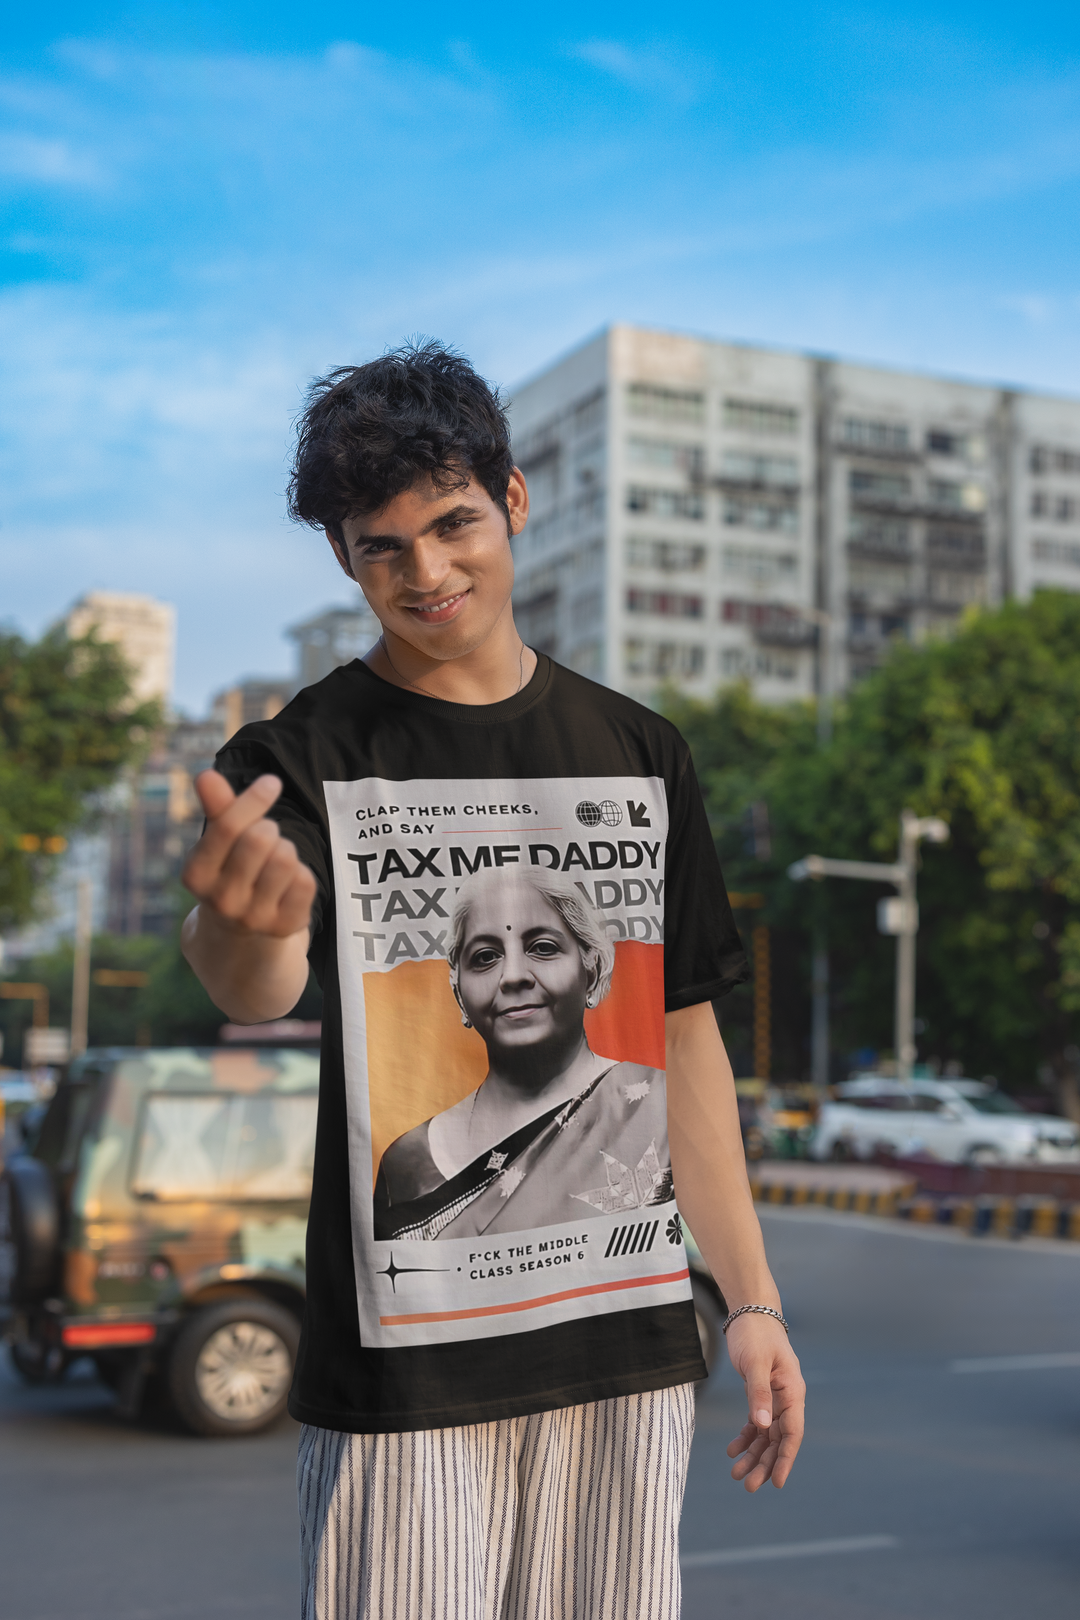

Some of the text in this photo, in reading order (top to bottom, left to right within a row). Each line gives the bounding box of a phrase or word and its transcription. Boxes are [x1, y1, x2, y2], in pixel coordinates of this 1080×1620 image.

[356, 804, 538, 821] CLAP THEM CHEEKS,
[358, 823, 435, 839] AND SAY
[347, 840, 661, 885] TAX ME DADDY
[351, 887, 450, 922] TAX
[352, 930, 448, 964] TAX
[508, 1245, 533, 1258] THE
[538, 1234, 588, 1252] MIDDLE
[470, 1250, 584, 1279] CLASS SEASON 6
